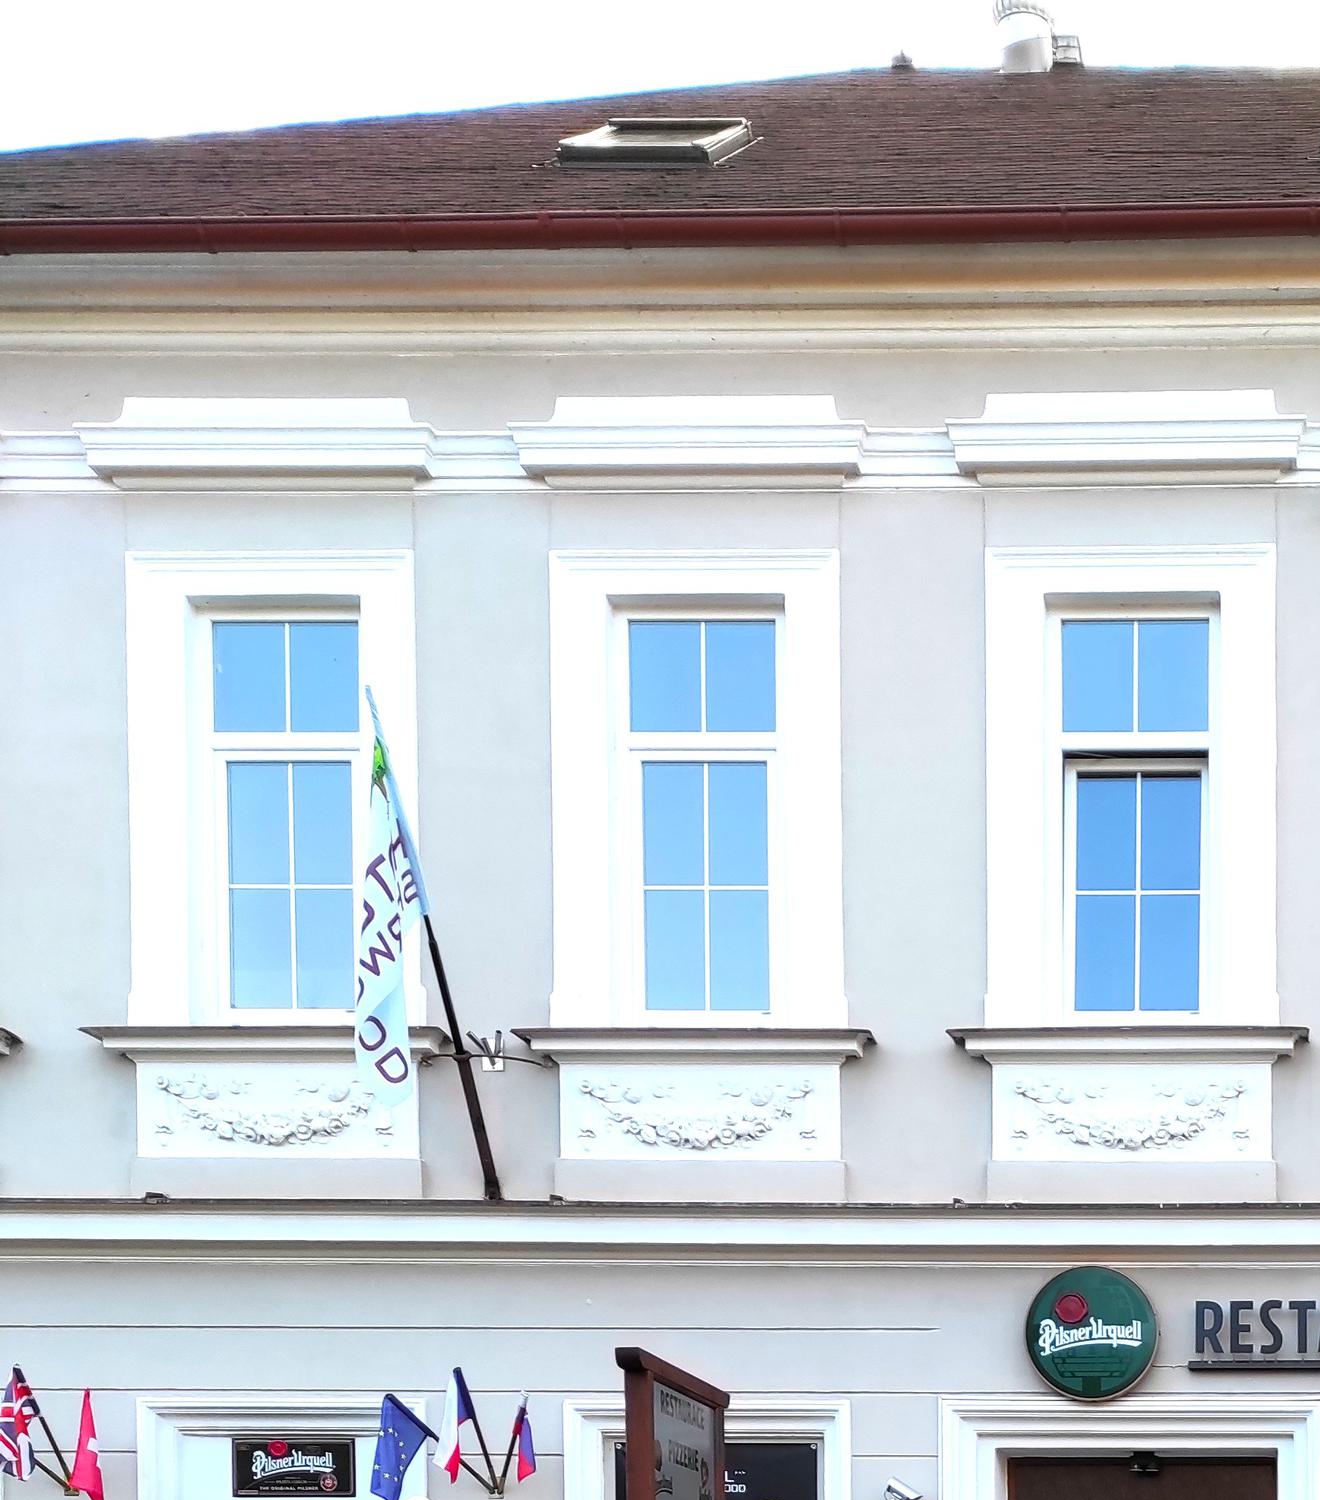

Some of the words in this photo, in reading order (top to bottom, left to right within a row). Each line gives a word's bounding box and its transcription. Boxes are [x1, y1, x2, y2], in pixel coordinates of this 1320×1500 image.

[1038, 1318, 1091, 1356] Pilsner
[1089, 1316, 1142, 1347] Urquell
[252, 1450, 294, 1480] Pilsner
[291, 1449, 333, 1473] Urquell
